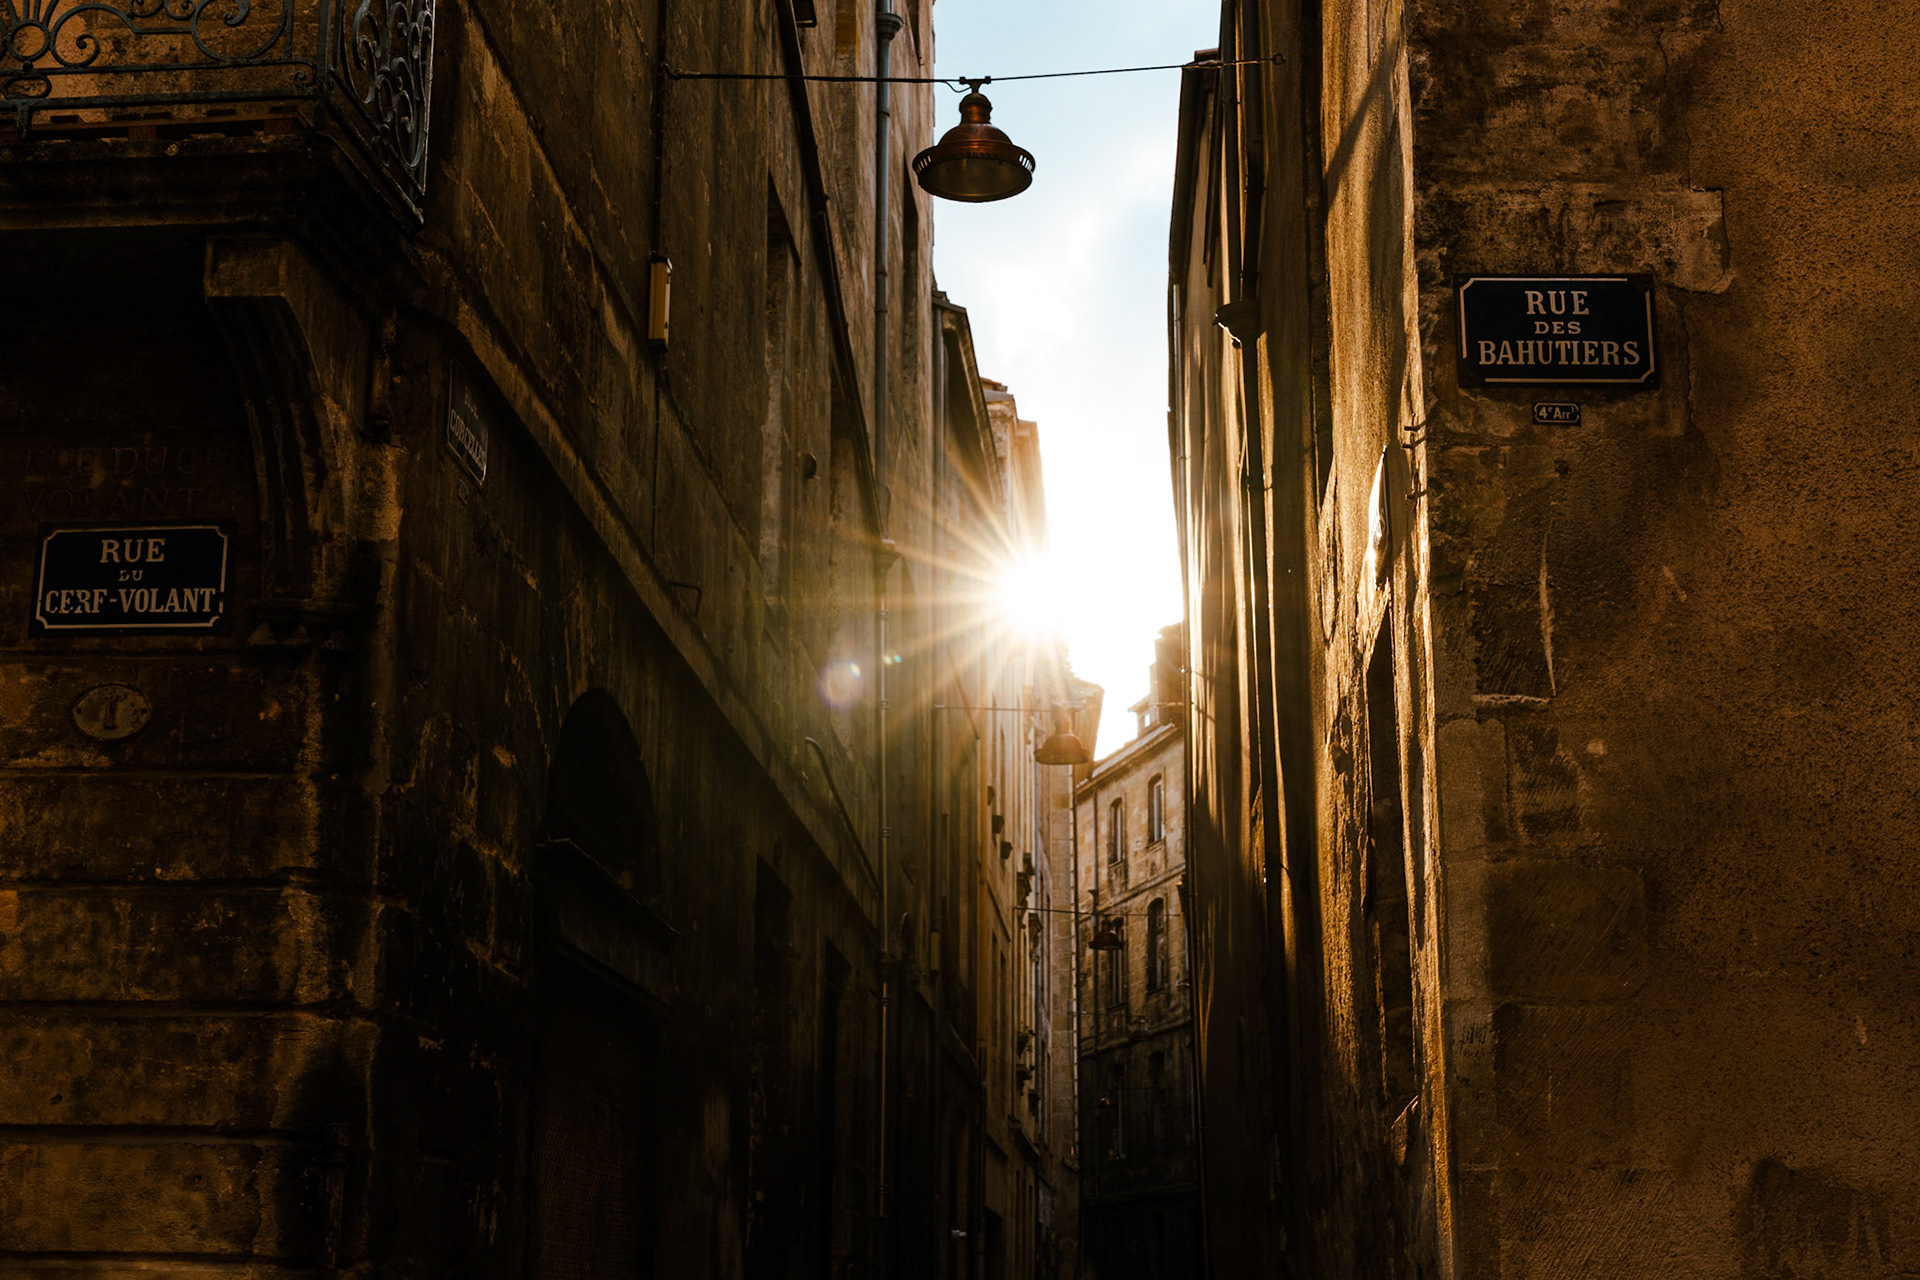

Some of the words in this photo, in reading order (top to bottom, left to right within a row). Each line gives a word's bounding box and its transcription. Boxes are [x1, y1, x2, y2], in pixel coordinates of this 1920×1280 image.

[1523, 289, 1590, 316] RUE
[1533, 320, 1582, 335] DES
[1477, 339, 1641, 366] BAHUTIERS
[25, 447, 97, 476] RUE
[112, 446, 169, 475] DU
[99, 537, 166, 564] RUE
[117, 569, 144, 582] DU
[44, 587, 216, 615] CERF-VOLANT
